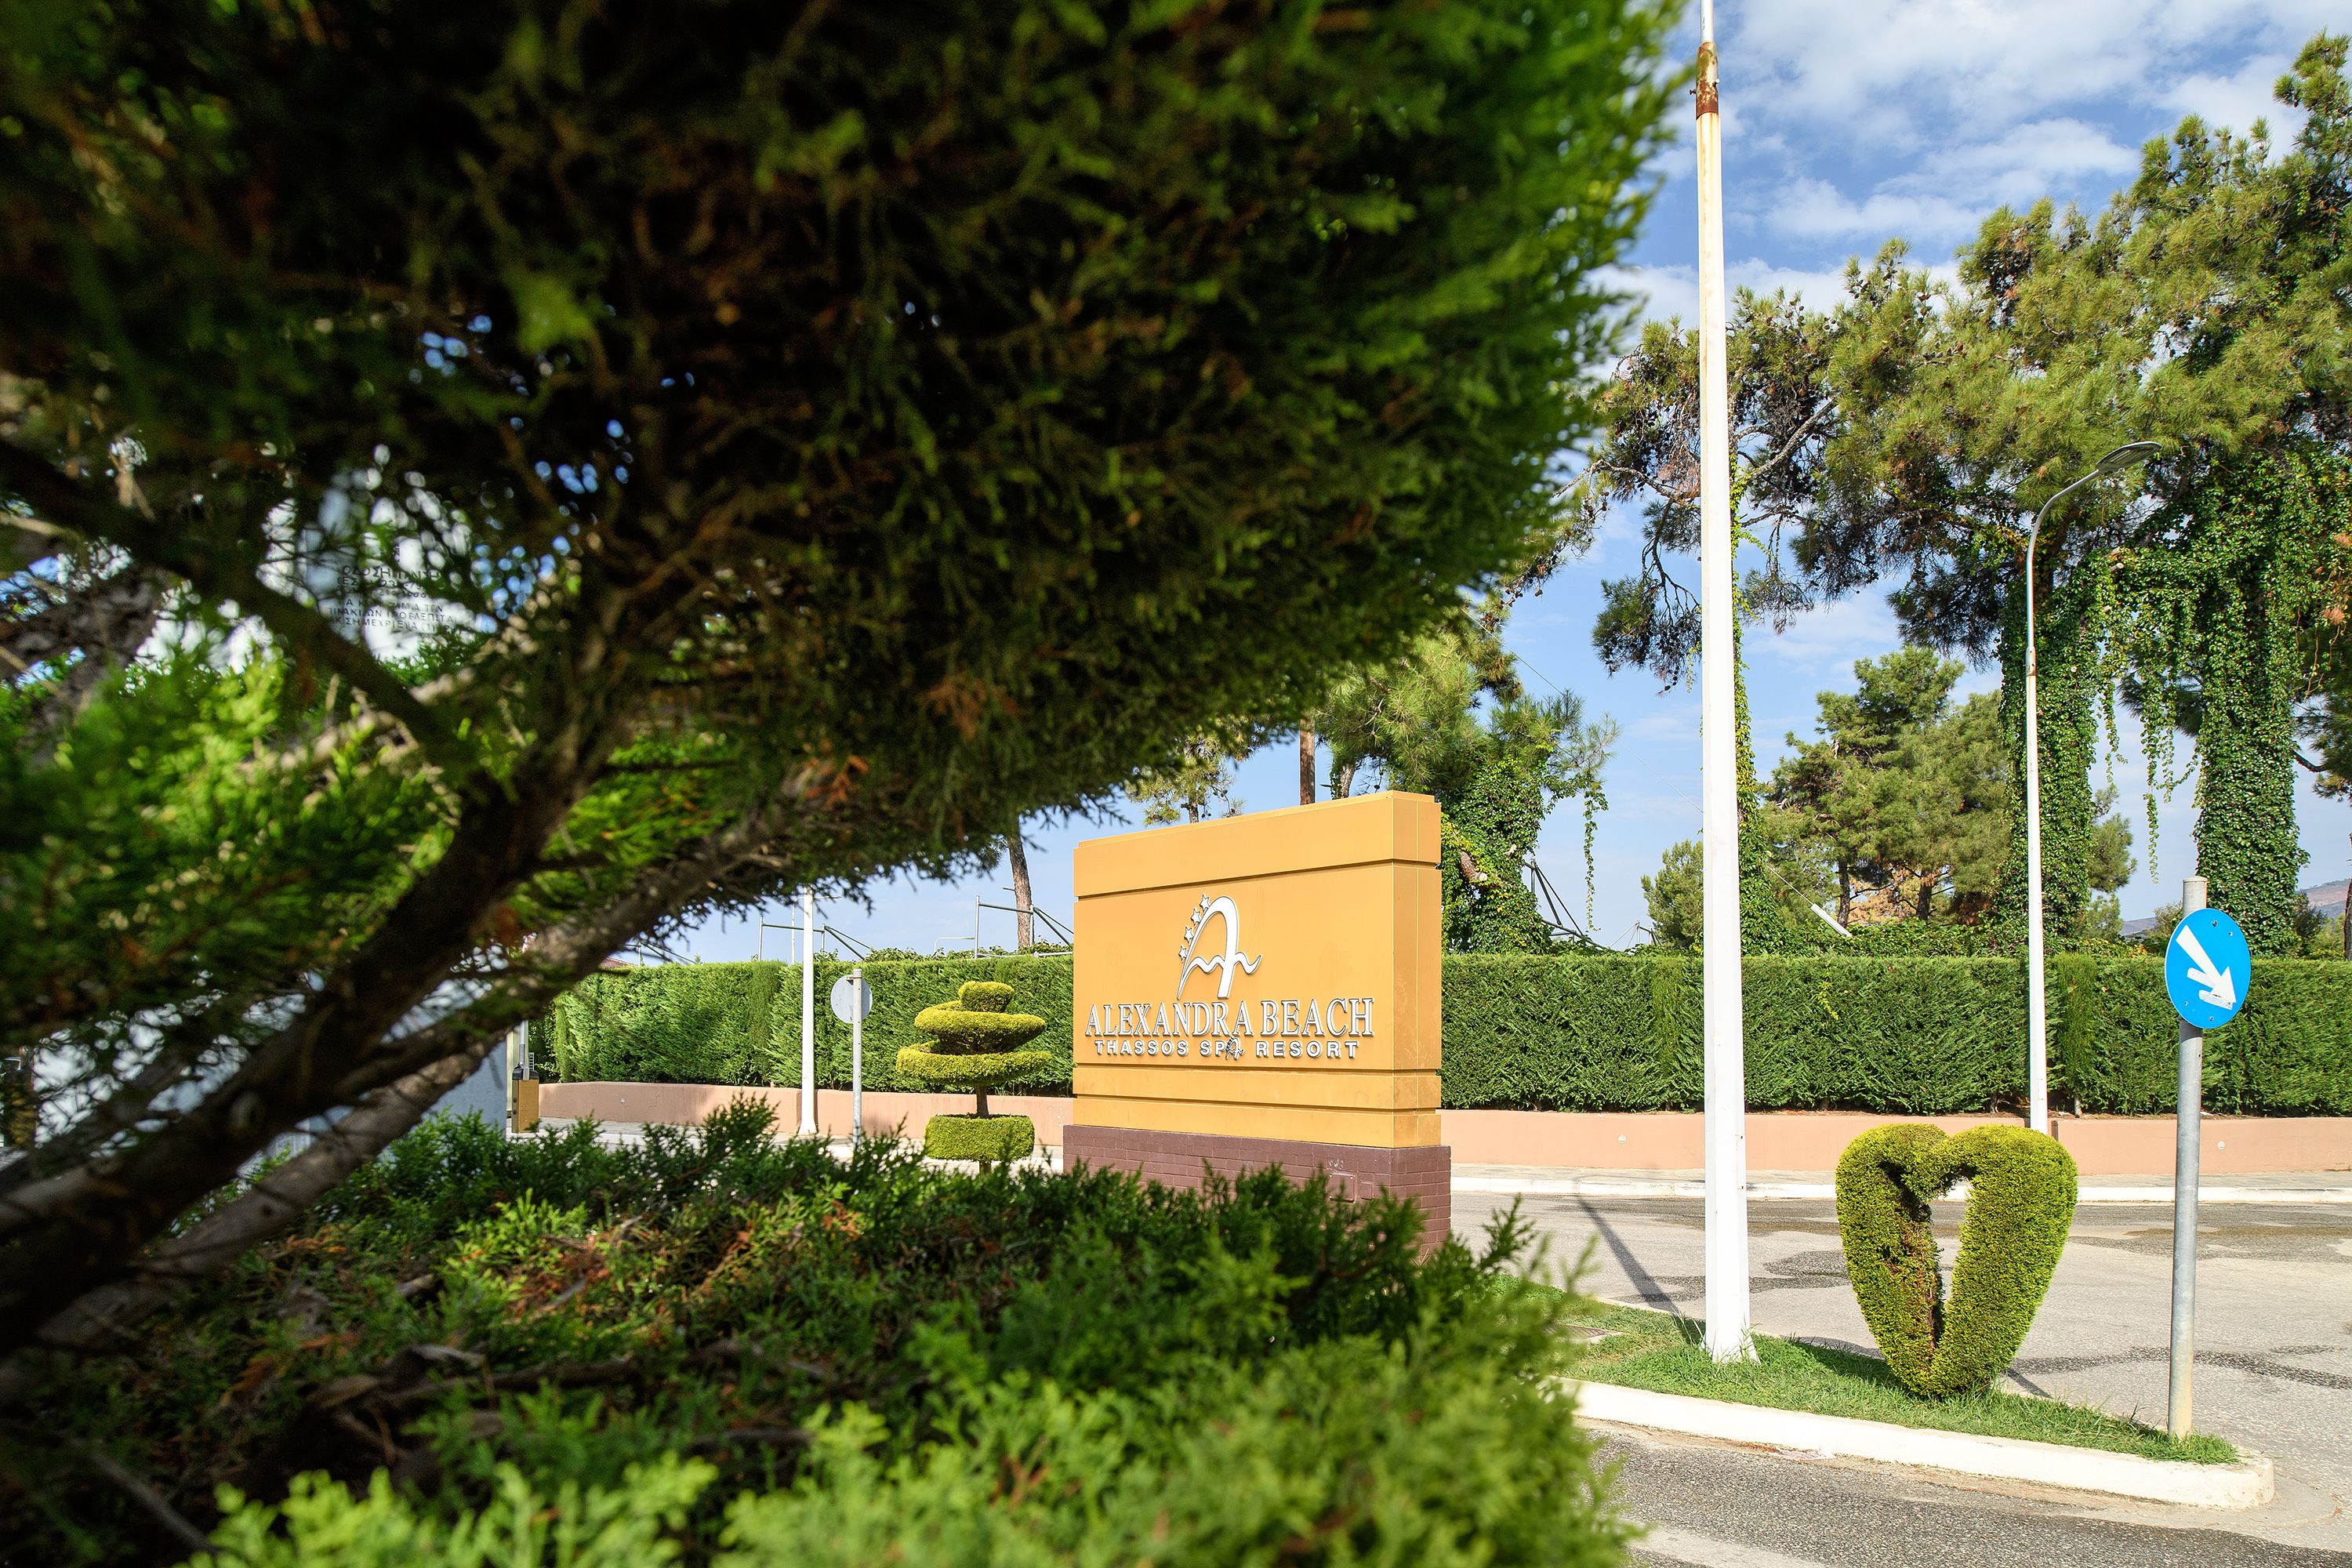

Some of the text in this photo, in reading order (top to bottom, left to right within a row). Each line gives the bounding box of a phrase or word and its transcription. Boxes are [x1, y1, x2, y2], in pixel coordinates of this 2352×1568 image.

[1084, 997, 1374, 1036] ALEXANDRA BEACH
[1094, 1036, 1359, 1060] THASSOS SPA RESORT
